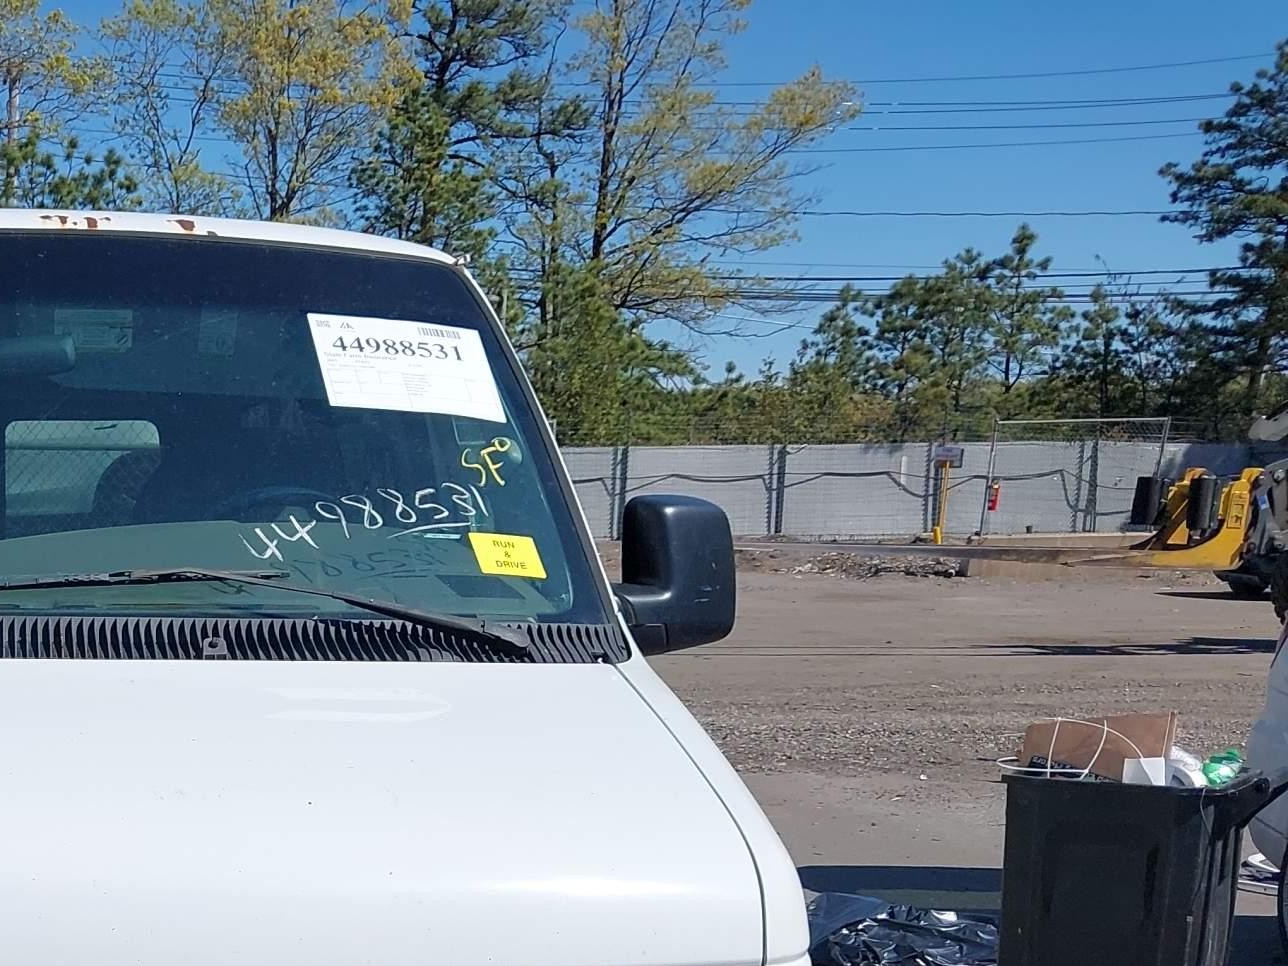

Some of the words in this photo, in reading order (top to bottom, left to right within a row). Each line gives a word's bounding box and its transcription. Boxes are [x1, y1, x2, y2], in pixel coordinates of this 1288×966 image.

[332, 336, 464, 361] 44988531
[238, 482, 489, 562] 44988531
[492, 540, 515, 549] RUN
[504, 550, 511, 558] &
[495, 560, 528, 570] DRIVE
